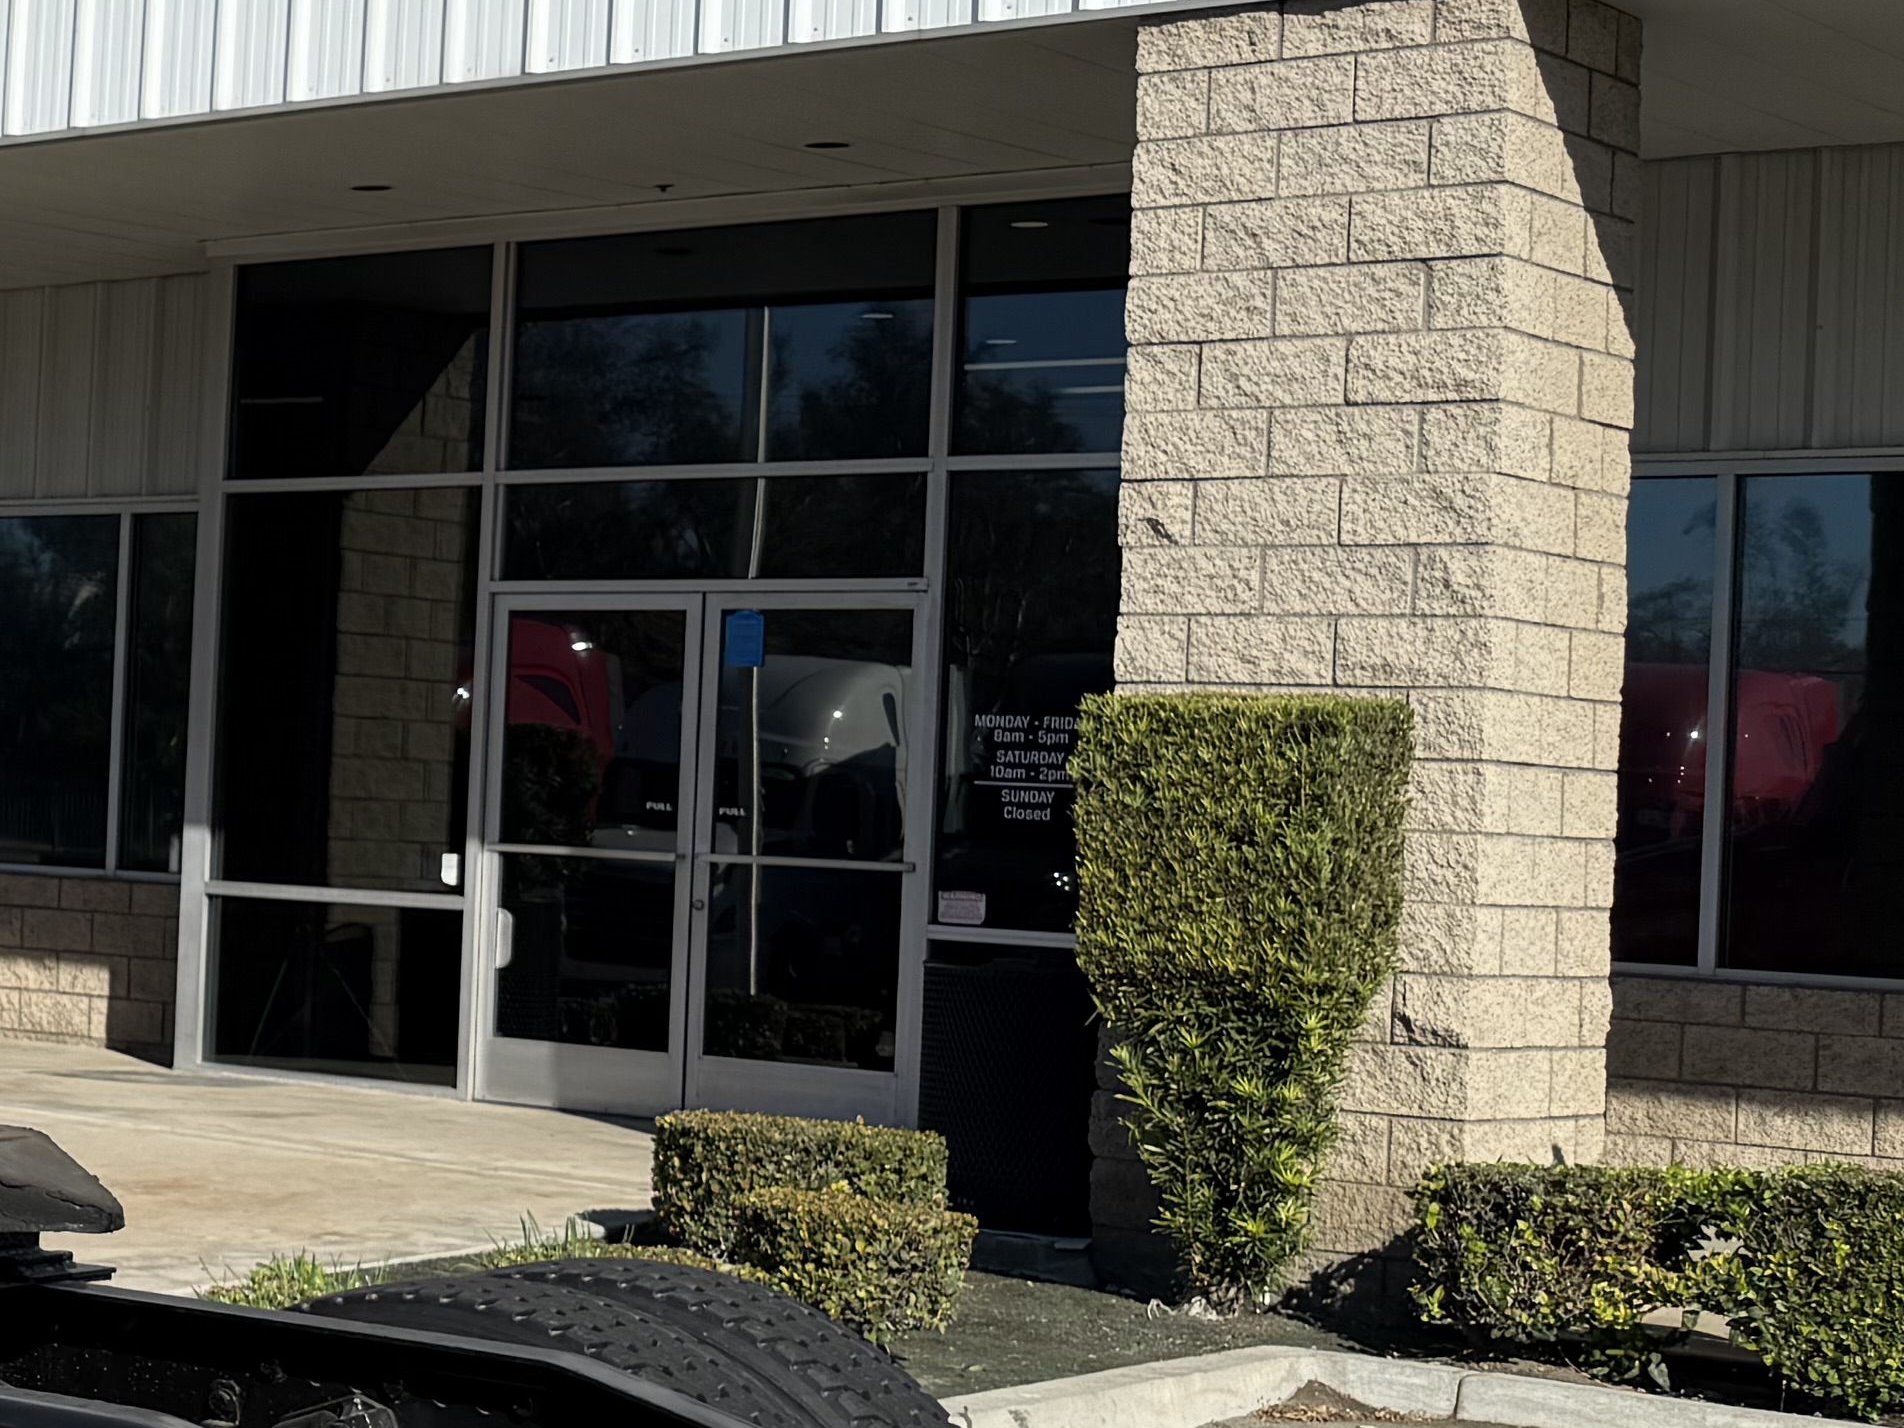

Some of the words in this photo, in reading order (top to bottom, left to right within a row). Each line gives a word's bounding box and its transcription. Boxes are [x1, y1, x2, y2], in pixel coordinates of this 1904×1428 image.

[974, 714, 1030, 728] MONDAY
[994, 729, 1025, 743] 8am
[1038, 730, 1069, 746] 5pm
[996, 750, 1065, 765] SATURDAY
[990, 765, 1026, 780] 10am
[1001, 789, 1055, 804] SUNDAY
[645, 801, 673, 811] PULL
[718, 807, 746, 816] PULL
[1003, 806, 1051, 821] Closed
